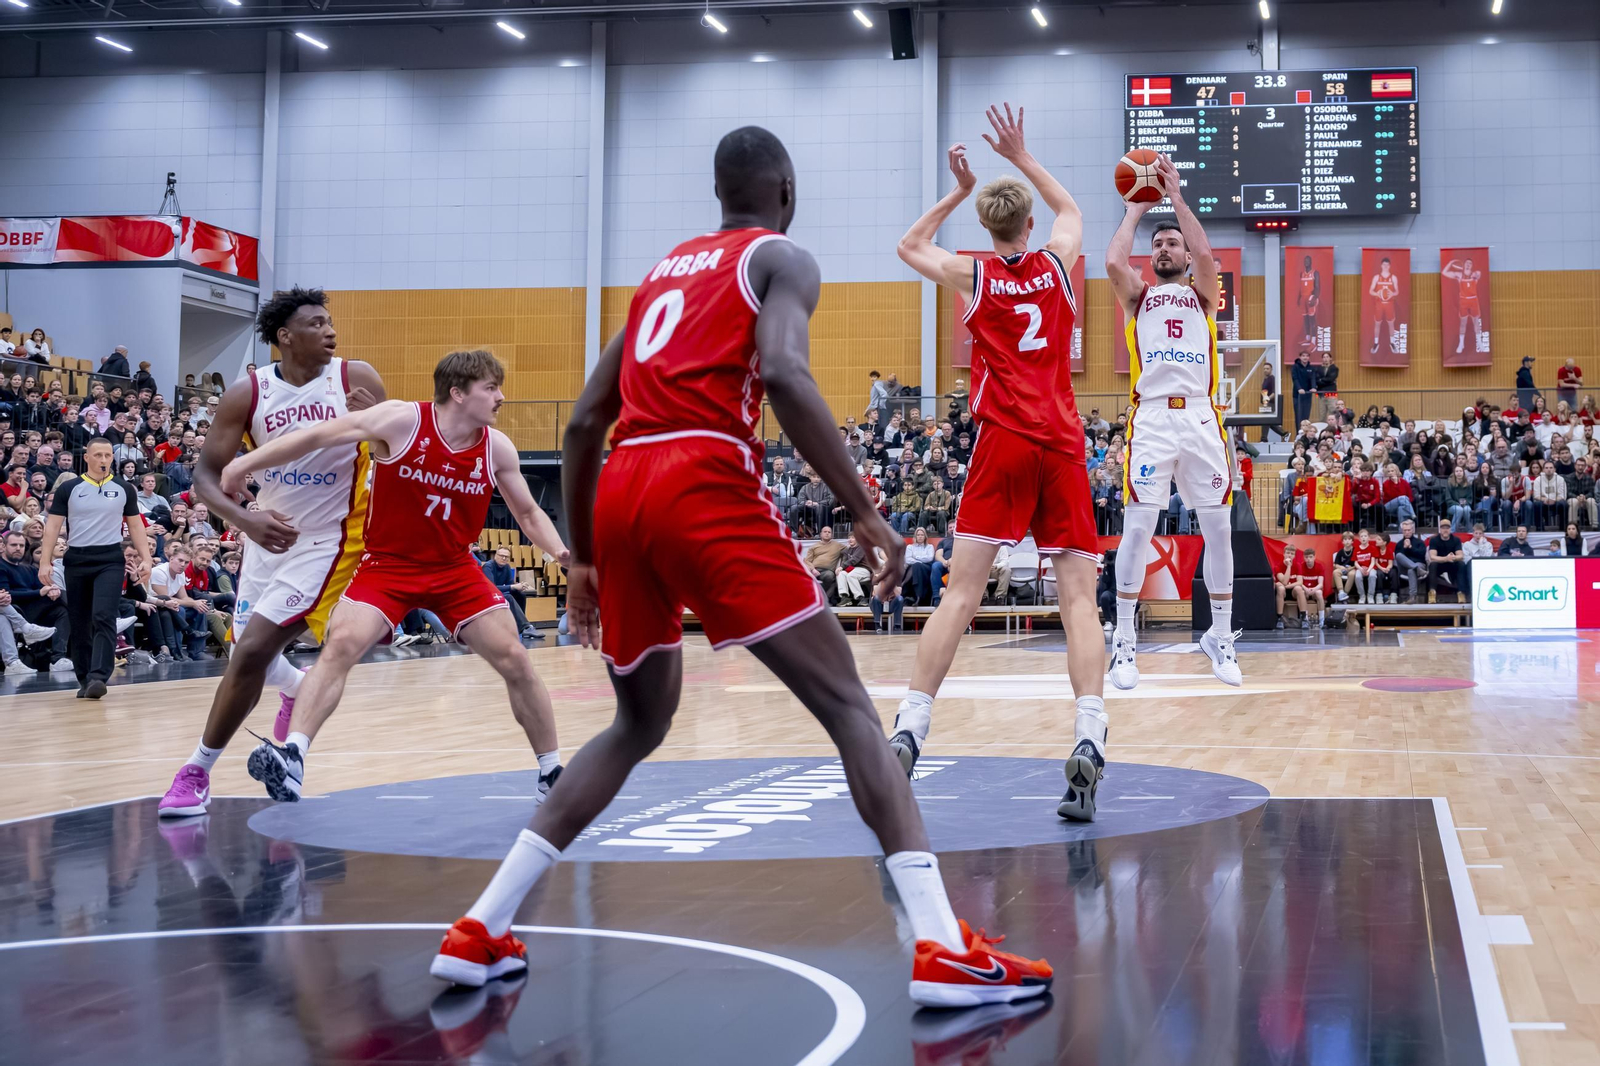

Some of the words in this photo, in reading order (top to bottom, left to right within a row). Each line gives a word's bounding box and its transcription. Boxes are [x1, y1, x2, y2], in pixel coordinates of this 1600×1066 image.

[1186, 76, 1227, 84] DENMARK
[1254, 75, 1286, 88] 33.8
[1322, 73, 1348, 81] SPAIN
[1196, 86, 1216, 98] 47
[1326, 83, 1345, 95] 58
[1266, 107, 1276, 120] 3
[1313, 105, 1348, 113] OSOBOR
[1138, 136, 1167, 144] JENSEN
[1265, 189, 1275, 201] 5
[650, 248, 724, 282] DIBBA
[990, 272, 1055, 295] MØLLER
[1146, 294, 1199, 313] ESPAÑA
[635, 289, 685, 364] 0
[1014, 303, 1048, 352] 2
[1164, 319, 1183, 339] 15
[1146, 348, 1205, 364] endesa
[264, 402, 337, 433] ESPAÑA
[264, 469, 337, 486] endesa
[399, 465, 487, 495] DANMARK
[424, 494, 452, 520] 71
[1508, 586, 1558, 601] Smart
